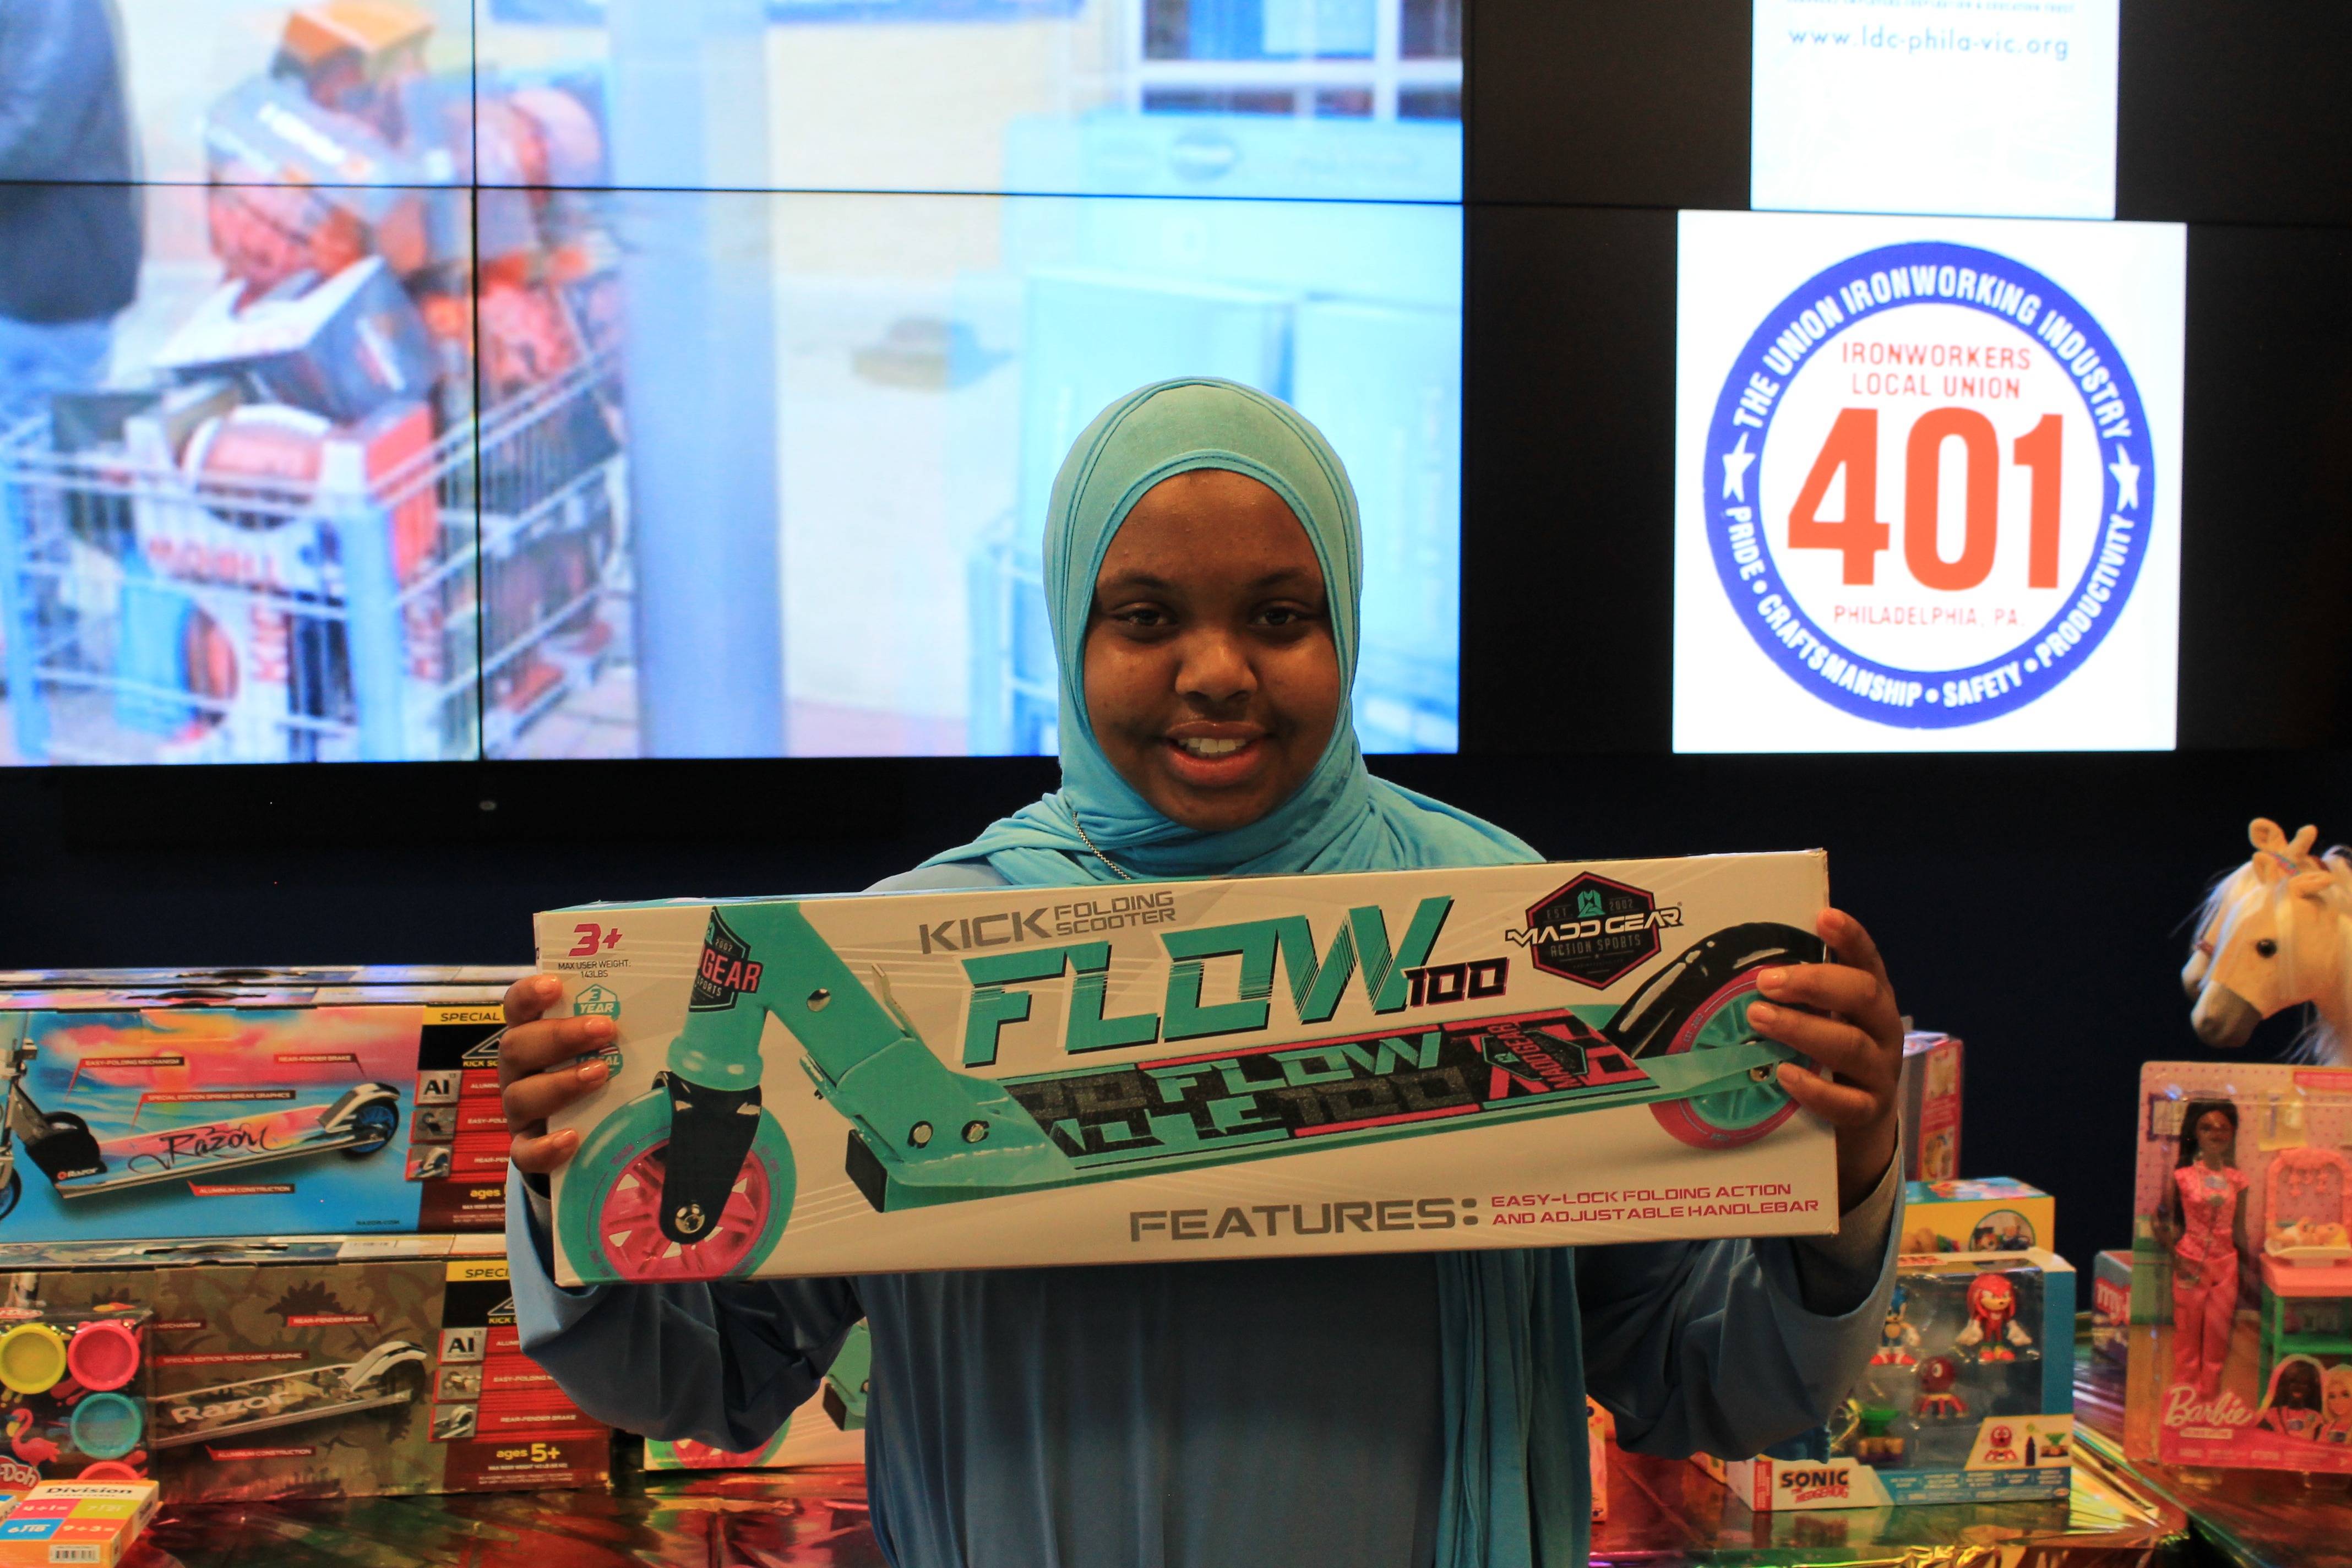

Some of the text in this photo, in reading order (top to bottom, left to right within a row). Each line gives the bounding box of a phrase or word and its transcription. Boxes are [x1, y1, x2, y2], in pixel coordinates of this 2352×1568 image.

[1788, 24, 2070, 61] www.ldc-phila-vic.org
[1733, 265, 2132, 439] THE UNION IRONWORKING INDUSTRY
[1842, 342, 2030, 370] IRONWORKERS
[1852, 373, 2020, 399] LOCAL UNION
[1787, 407, 2063, 591] 401
[1725, 506, 2135, 708] PRIDE CRAFTSMANSHIP SAFETY PRODUCTIVITY
[1054, 890, 1174, 921] FOLDING
[1546, 898, 1634, 920] EST. 2002
[918, 906, 1053, 954] KICK
[1055, 908, 1176, 937] SCOOTER
[1506, 906, 1684, 948] MADD GEAR
[568, 923, 623, 956] 3+
[715, 939, 733, 952] 2002
[1550, 934, 1641, 957] ACTION SPORTS
[581, 970, 608, 978] 143LBS
[599, 959, 631, 968] WEIGHT:
[701, 948, 761, 992] GEAR
[589, 988, 602, 1002] 3
[696, 976, 722, 997] SPORTS
[959, 895, 1455, 1069] FLOW
[1401, 956, 1510, 1008] 100
[440, 1012, 500, 1022] SPECIAL
[580, 1003, 614, 1014] YEAR
[1144, 1031, 1441, 1103] FLOW
[151, 1124, 269, 1167] Razor
[67, 1167, 99, 1178] Razor
[470, 1189, 500, 1199] ages
[1491, 1183, 1792, 1207] EASY-LOCK FOLDING ACTION
[1130, 1197, 1479, 1242] FEATURES:
[1492, 1200, 1819, 1225] AND ADJUSTABLE HANDLEBAR
[171, 1392, 289, 1424] Razor
[2164, 1386, 2253, 1427] Barbie
[497, 1442, 560, 1462] ages 5+
[1779, 1469, 1849, 1488] SONIC
